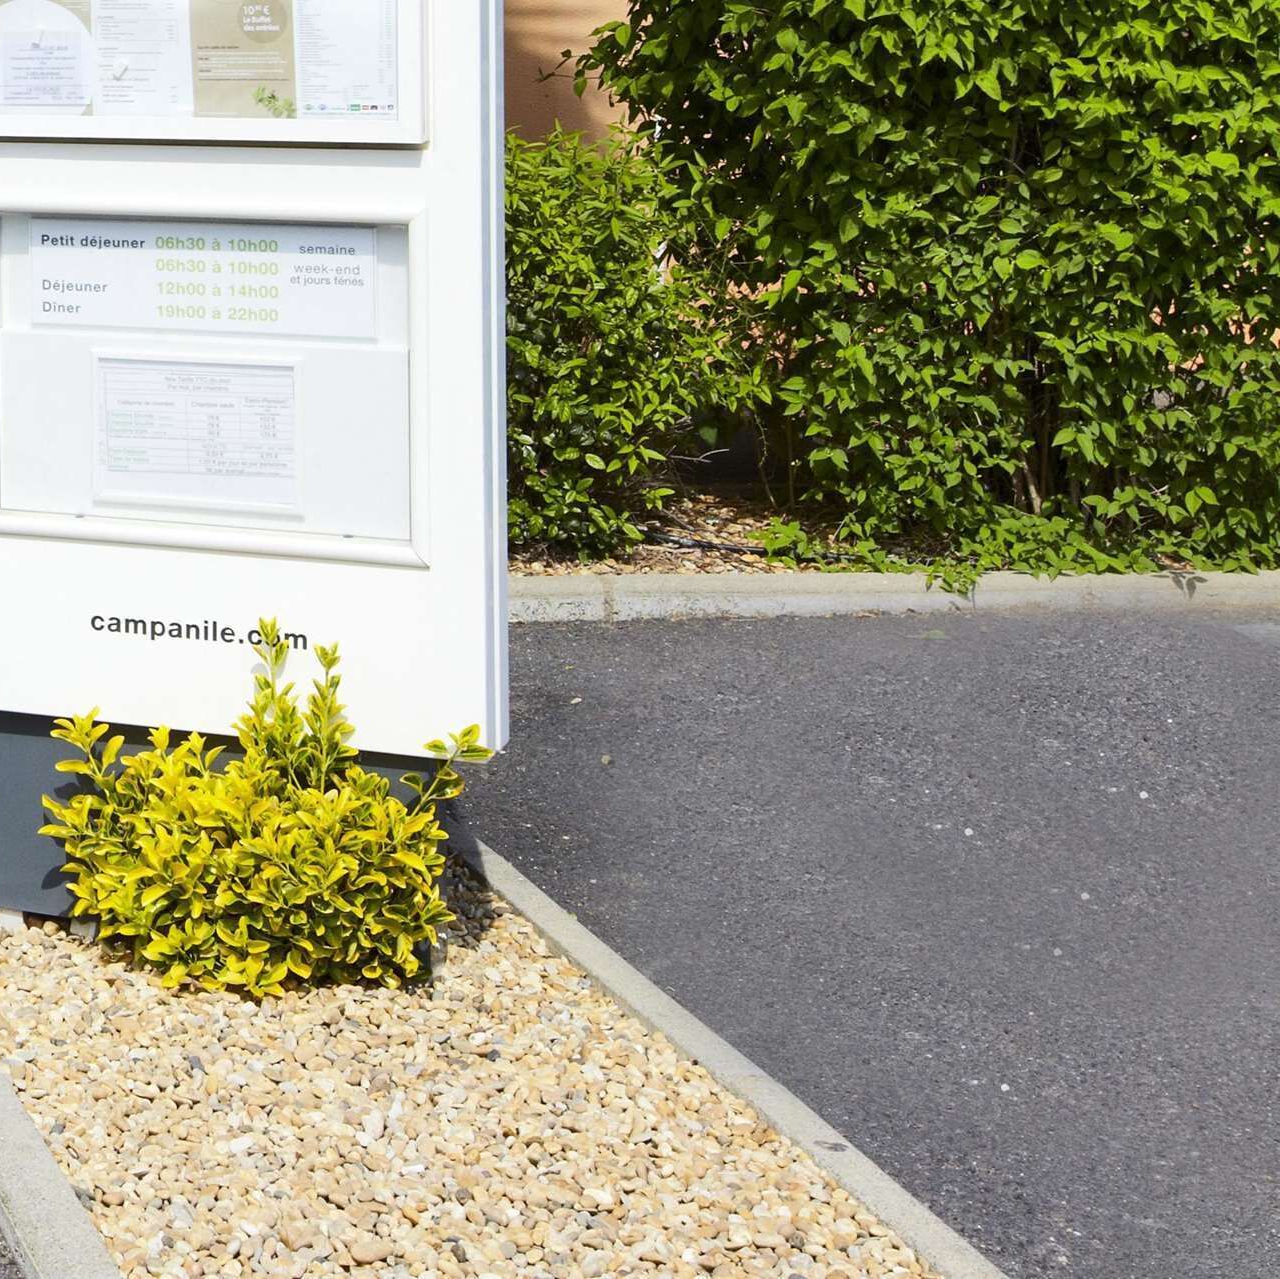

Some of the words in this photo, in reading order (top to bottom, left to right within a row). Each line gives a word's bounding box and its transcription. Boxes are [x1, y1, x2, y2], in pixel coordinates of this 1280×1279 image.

[41, 234, 76, 248] Petit
[79, 234, 146, 251] déjeuner
[155, 236, 206, 251] 06h30
[210, 238, 222, 252] à
[227, 238, 279, 253] 10h00
[298, 244, 357, 256] semaine
[155, 258, 206, 274] 06h30
[210, 260, 222, 274] à
[227, 261, 279, 276] 10h00
[293, 263, 361, 276] week-end
[41, 279, 108, 295] Déjeuner
[156, 282, 206, 297] 12h00
[210, 284, 222, 298] à
[227, 284, 279, 299] 14h00
[302, 275, 331, 288] jours
[156, 305, 206, 320] 19h00
[227, 307, 279, 322] 22h00
